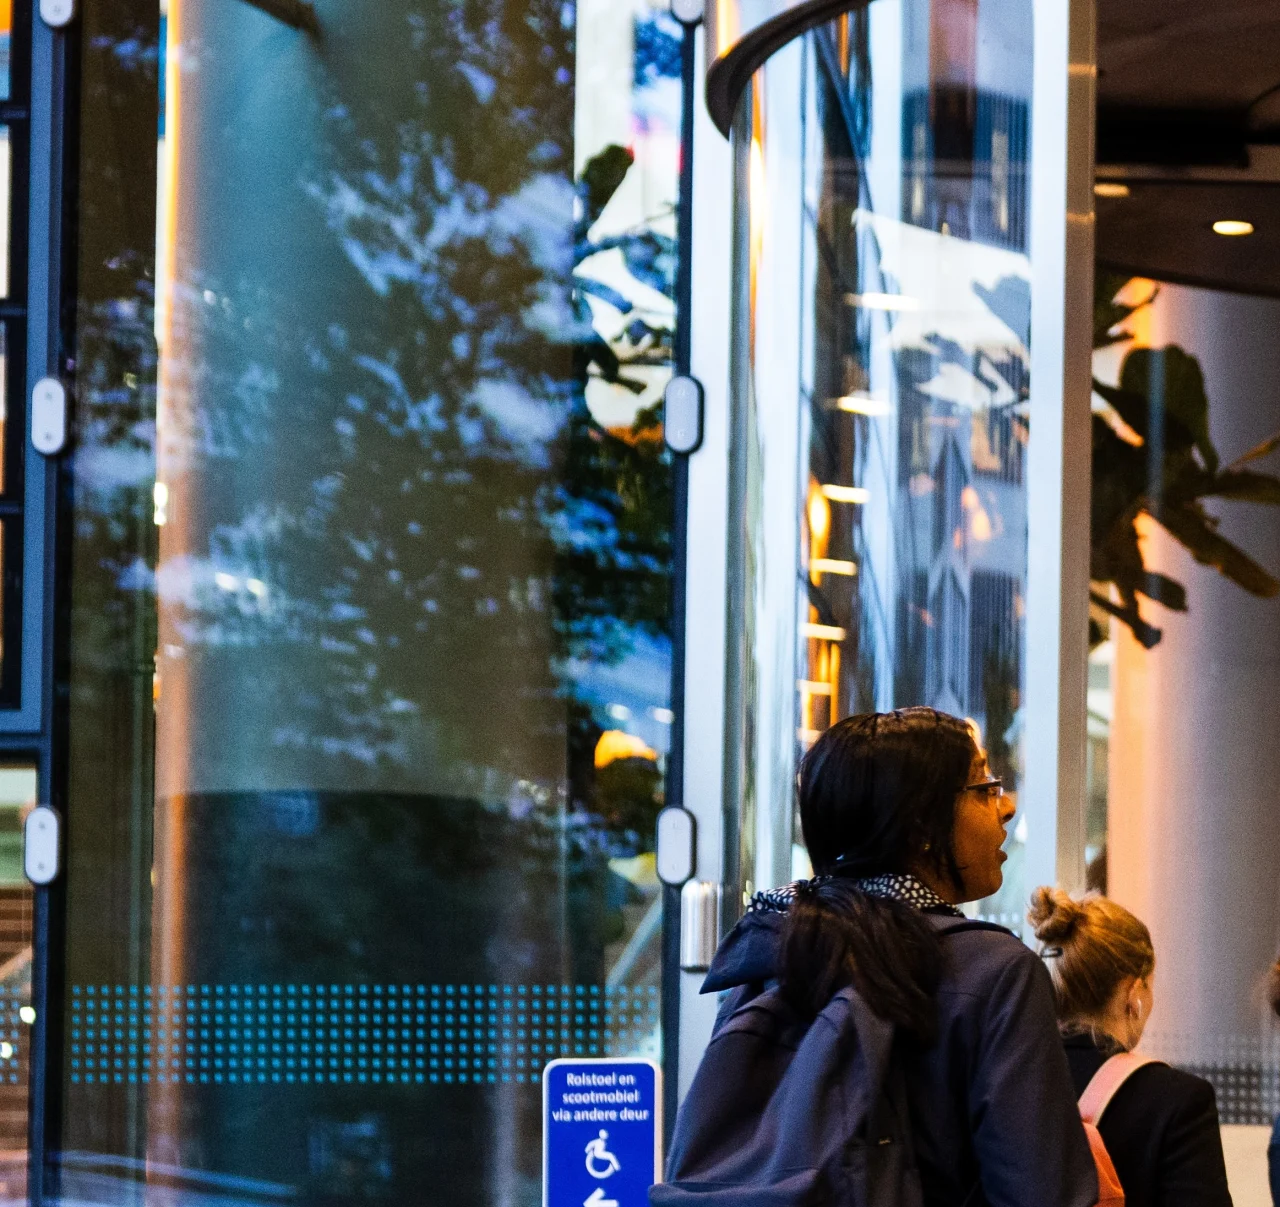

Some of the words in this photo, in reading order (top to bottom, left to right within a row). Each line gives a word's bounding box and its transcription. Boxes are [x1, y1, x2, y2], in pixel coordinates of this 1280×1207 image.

[566, 1072, 616, 1086] Rolstoel
[618, 1074, 635, 1086] en
[562, 1089, 639, 1104] scootmobiel
[552, 1107, 571, 1122] via
[573, 1107, 617, 1122] andere
[619, 1107, 649, 1121] deur
